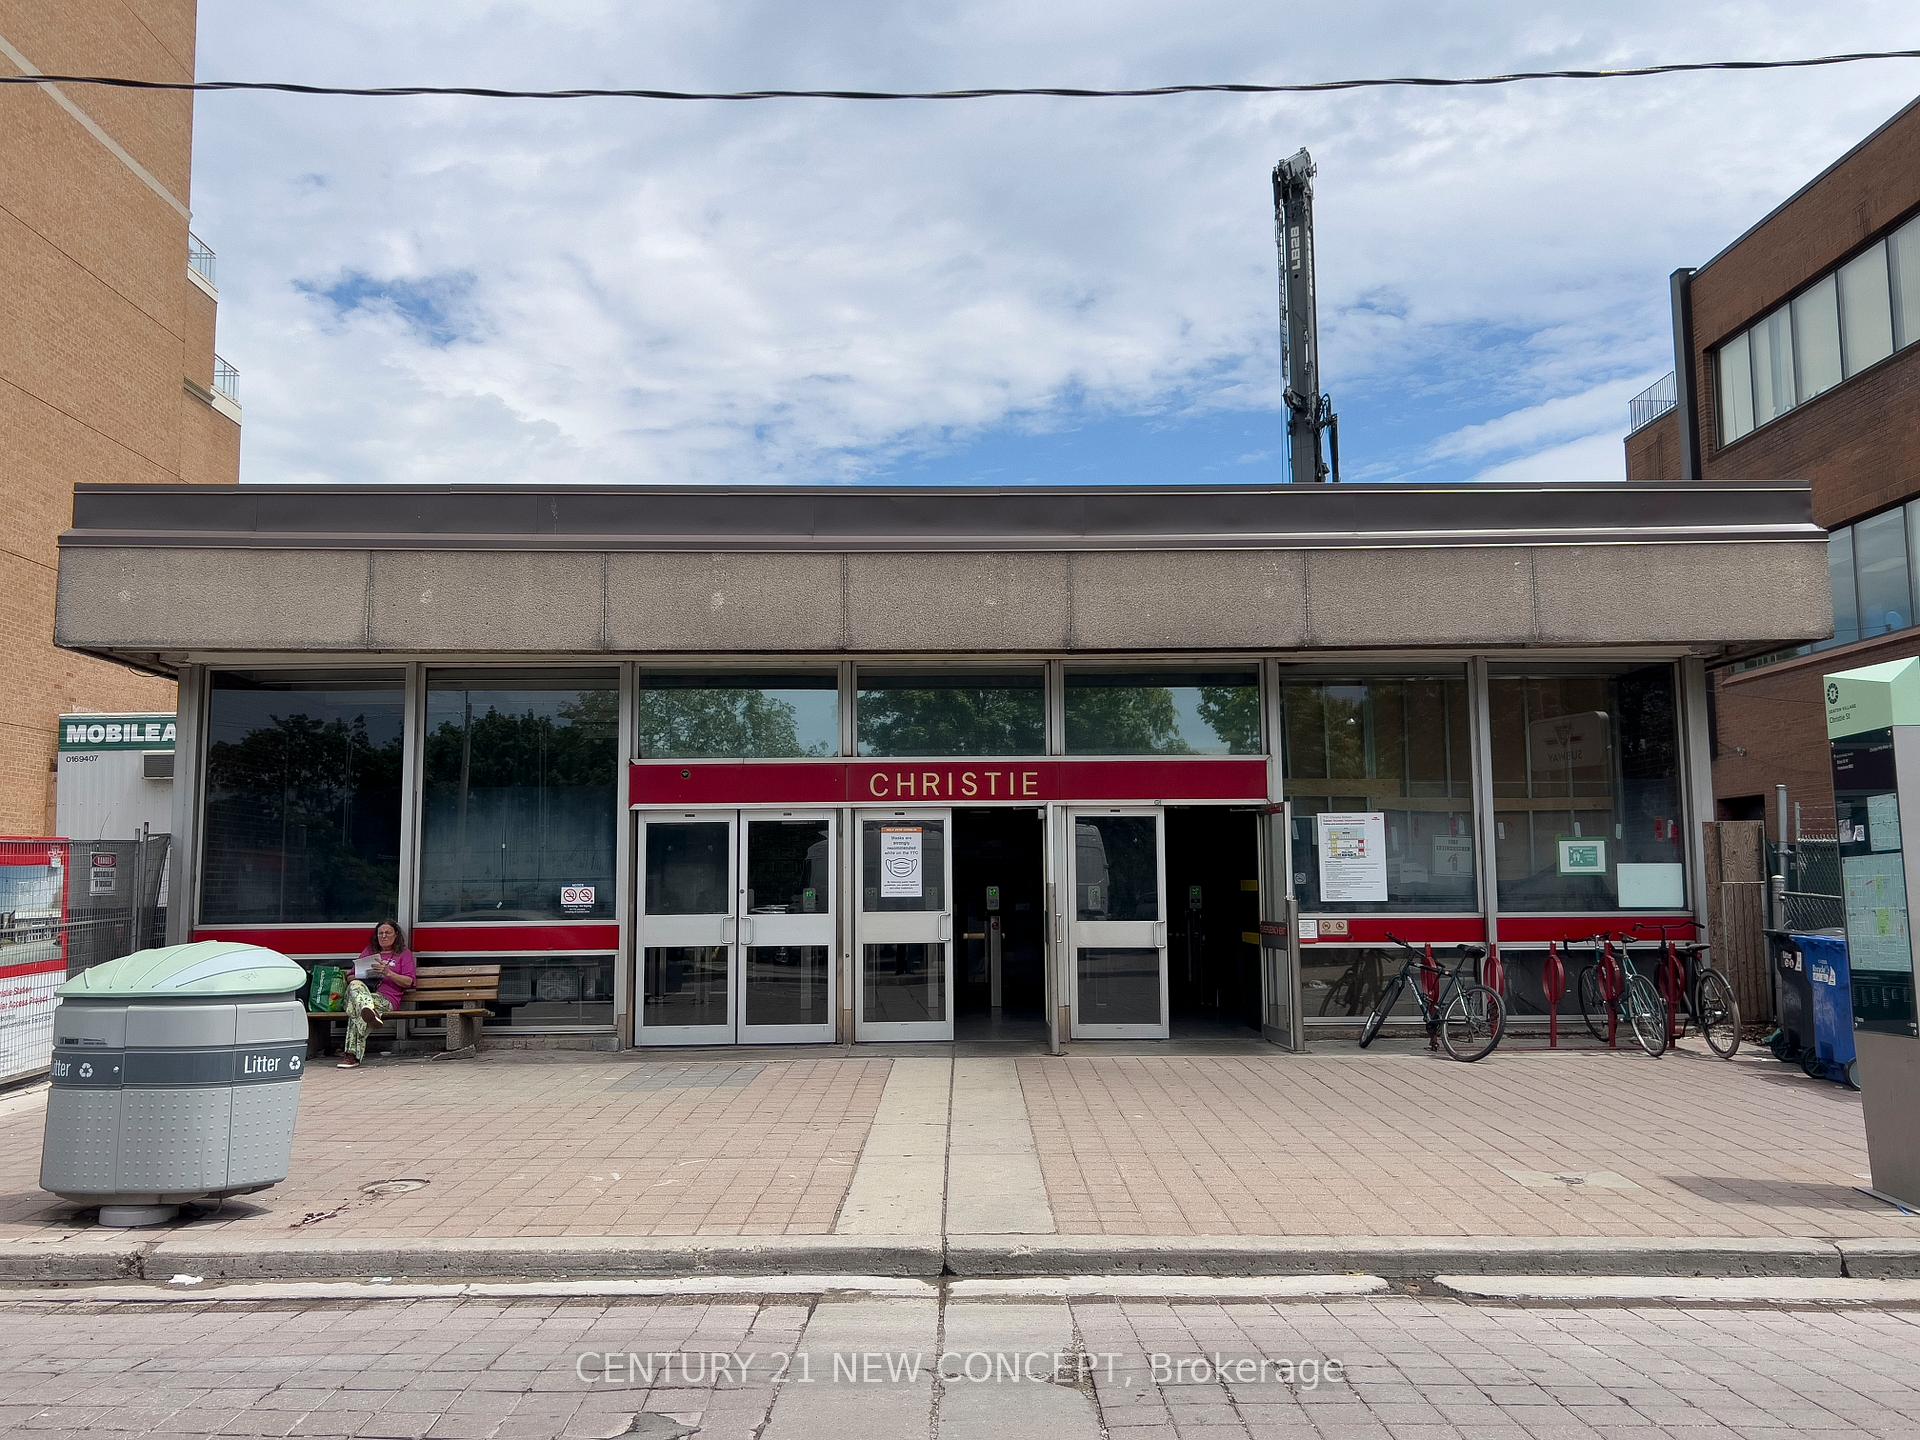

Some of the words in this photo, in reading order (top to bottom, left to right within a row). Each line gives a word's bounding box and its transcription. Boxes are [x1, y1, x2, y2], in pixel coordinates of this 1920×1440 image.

[1290, 226, 1300, 270] LB28
[65, 755, 99, 763] 0169407
[869, 771, 1039, 797] CHRISTIE
[244, 1055, 281, 1074] Litter
